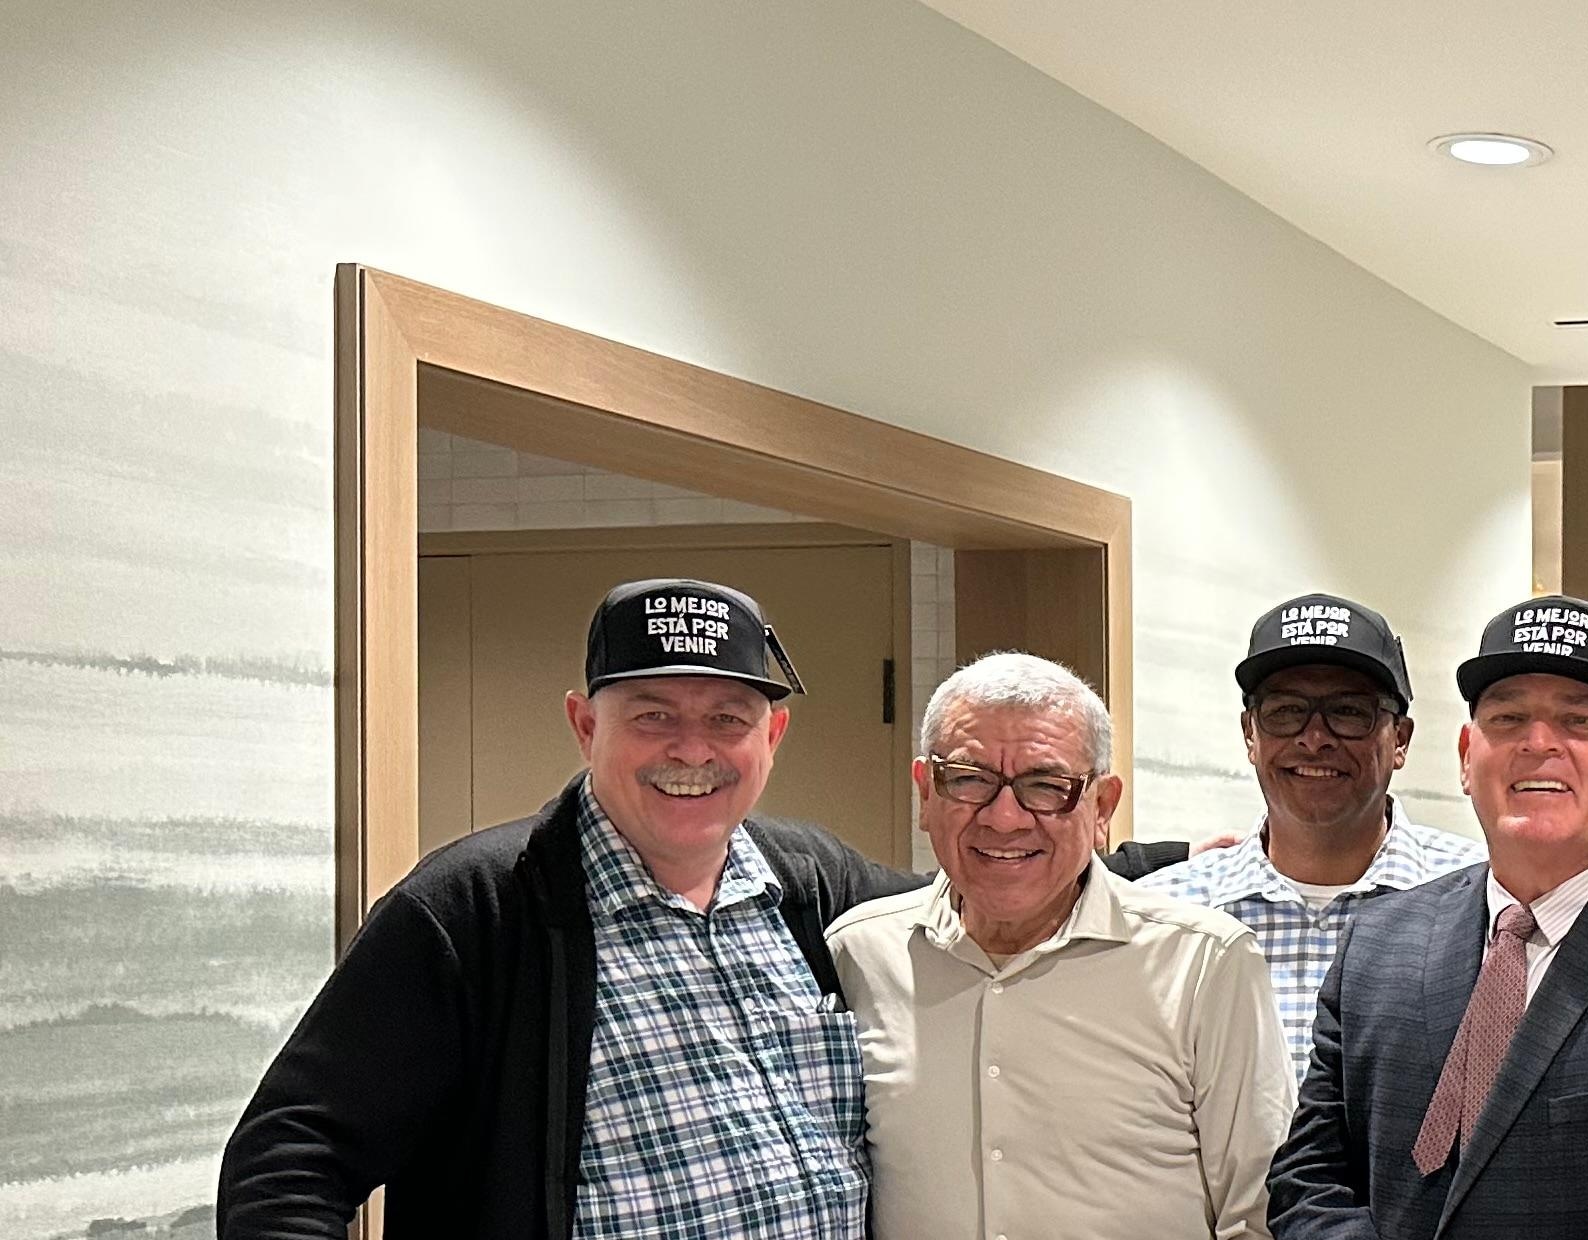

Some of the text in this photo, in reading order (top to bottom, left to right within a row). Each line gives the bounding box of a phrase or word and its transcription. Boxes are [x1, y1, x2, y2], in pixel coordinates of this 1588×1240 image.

[645, 597, 730, 620] LO MEJOR
[1281, 605, 1351, 623] LO MEJOR
[1514, 609, 1534, 625] LO
[647, 613, 729, 640] ESTÁ POR
[1281, 618, 1349, 639] ESTÁ POR
[1513, 623, 1588, 646] ESTÁ POR
[660, 636, 718, 656] VENIR
